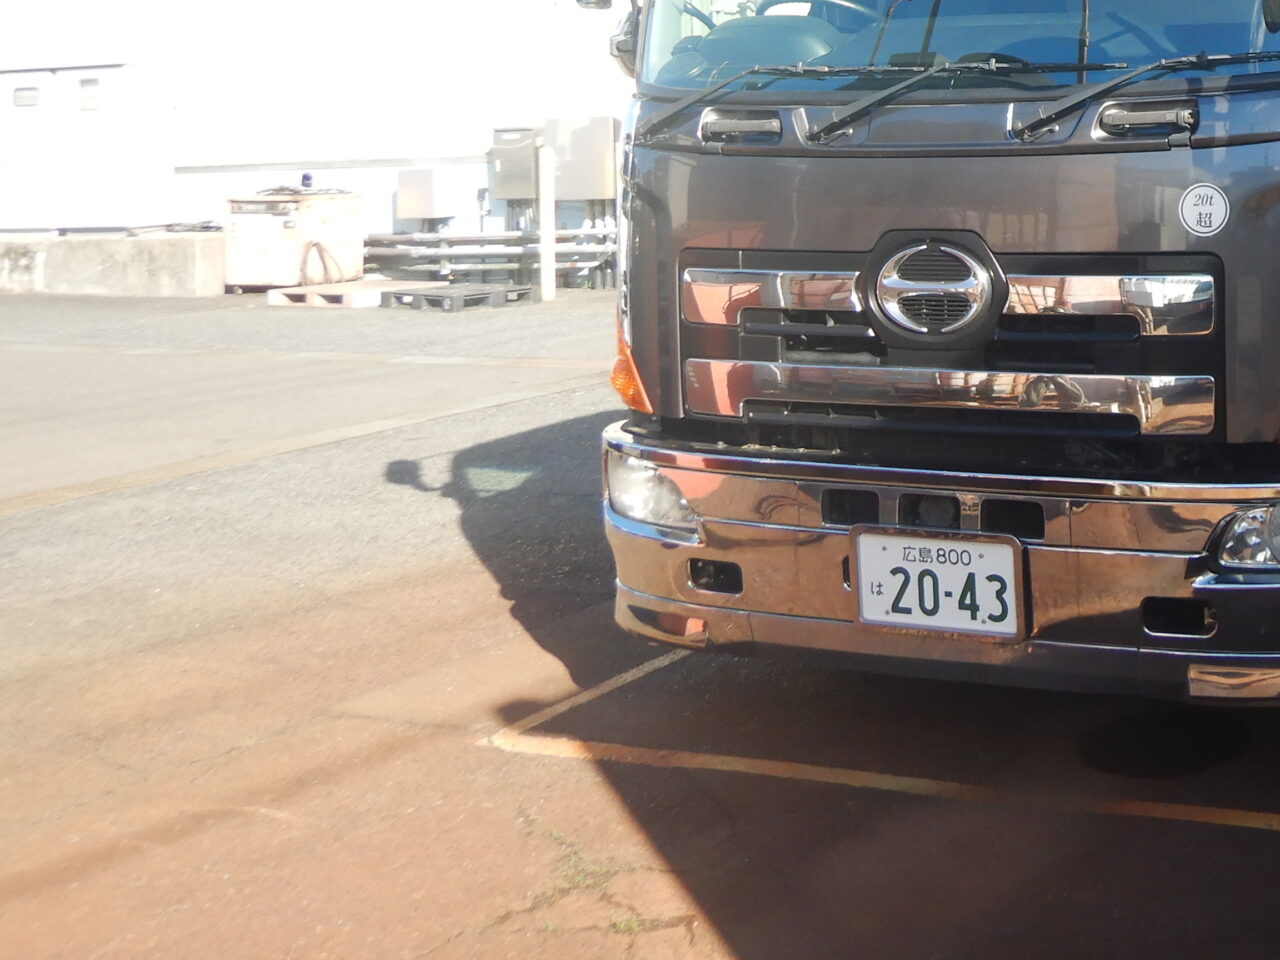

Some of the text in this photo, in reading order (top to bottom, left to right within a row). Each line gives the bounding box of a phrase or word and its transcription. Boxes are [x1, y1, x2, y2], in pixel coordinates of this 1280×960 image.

[1193, 193, 1214, 207] 20t
[1196, 211, 1212, 228] 超
[870, 566, 1009, 623] は 20-43
